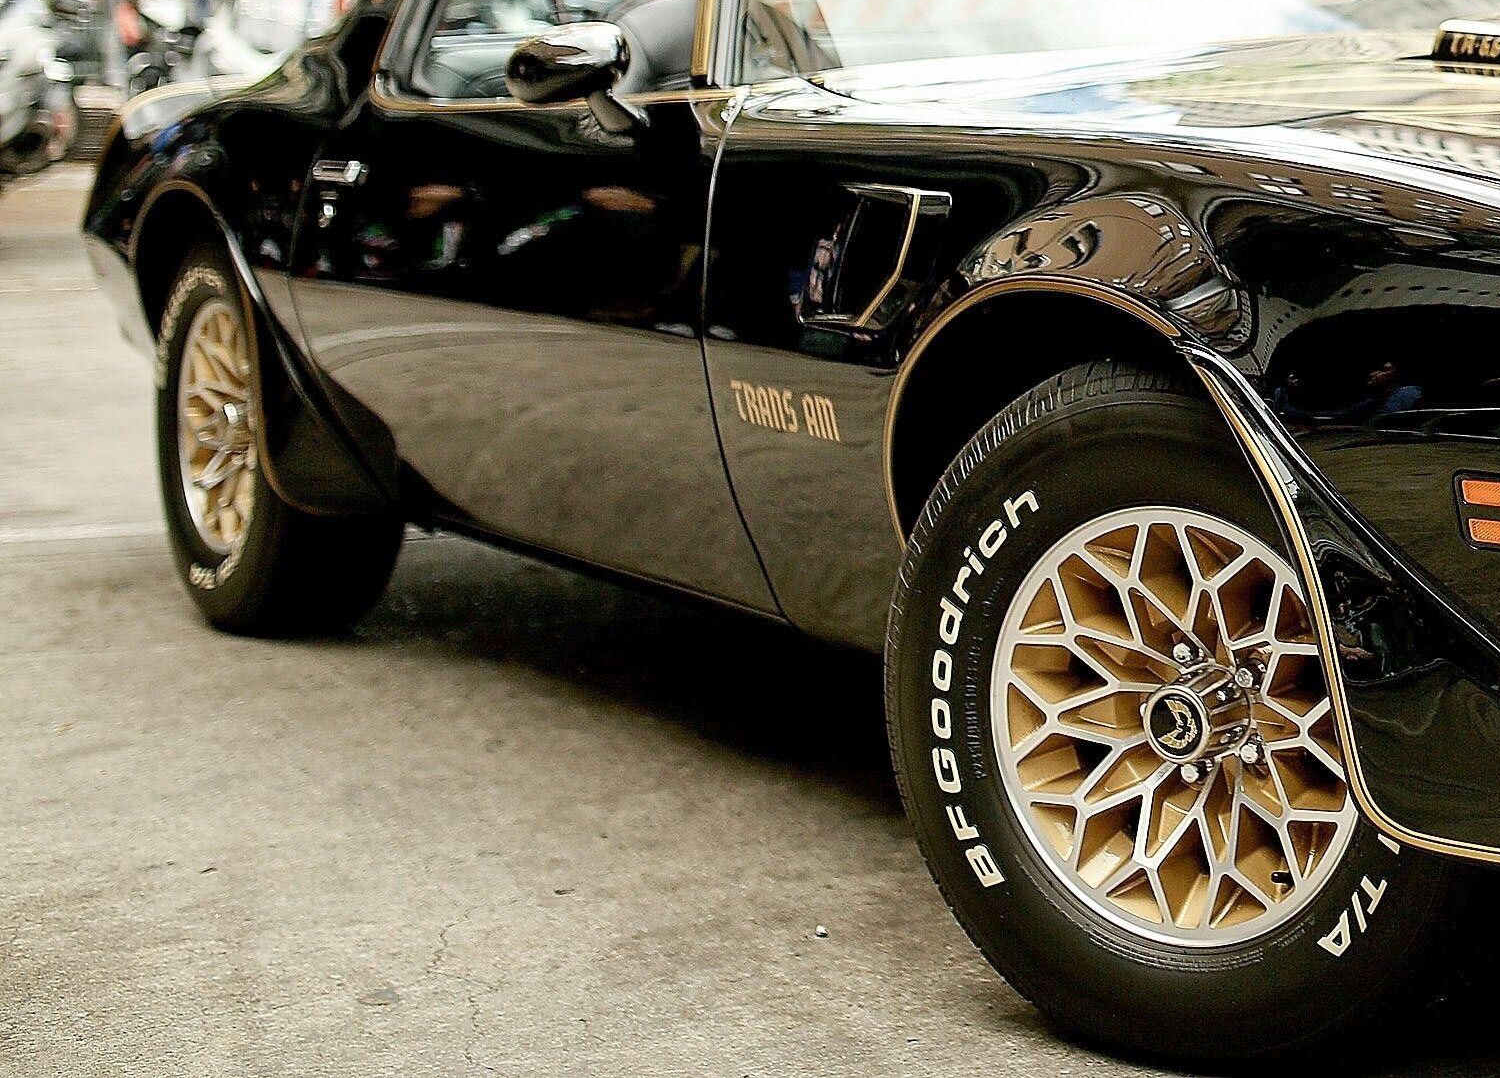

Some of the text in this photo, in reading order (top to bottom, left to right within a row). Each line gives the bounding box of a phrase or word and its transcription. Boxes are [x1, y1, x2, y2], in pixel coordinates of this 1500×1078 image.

[730, 379, 841, 443] TRANS AM
[1315, 874, 1388, 958] T/A
